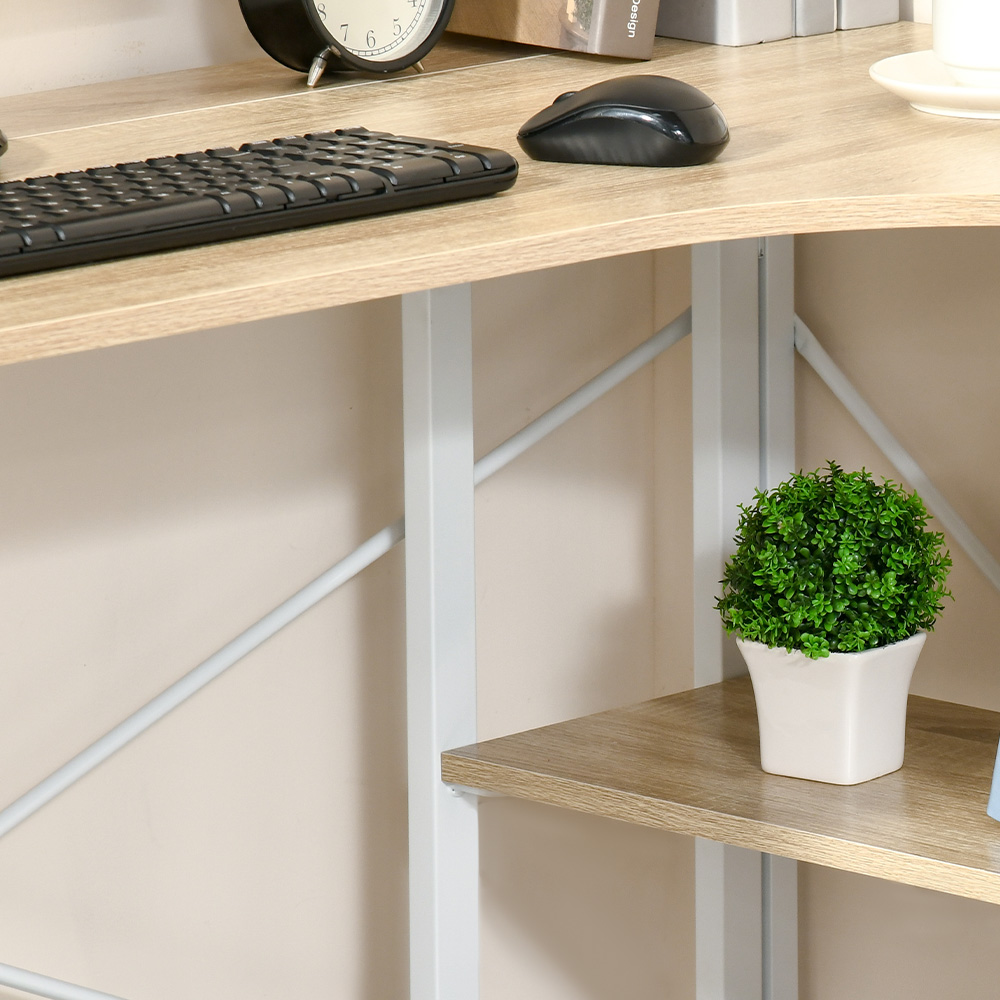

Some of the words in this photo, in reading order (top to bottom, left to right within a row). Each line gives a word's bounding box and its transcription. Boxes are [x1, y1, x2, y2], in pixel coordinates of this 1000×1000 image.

[318, 3, 327, 21] 8
[340, 24, 349, 42] 7
[393, 18, 402, 36] 5
[366, 30, 376, 48] 6
